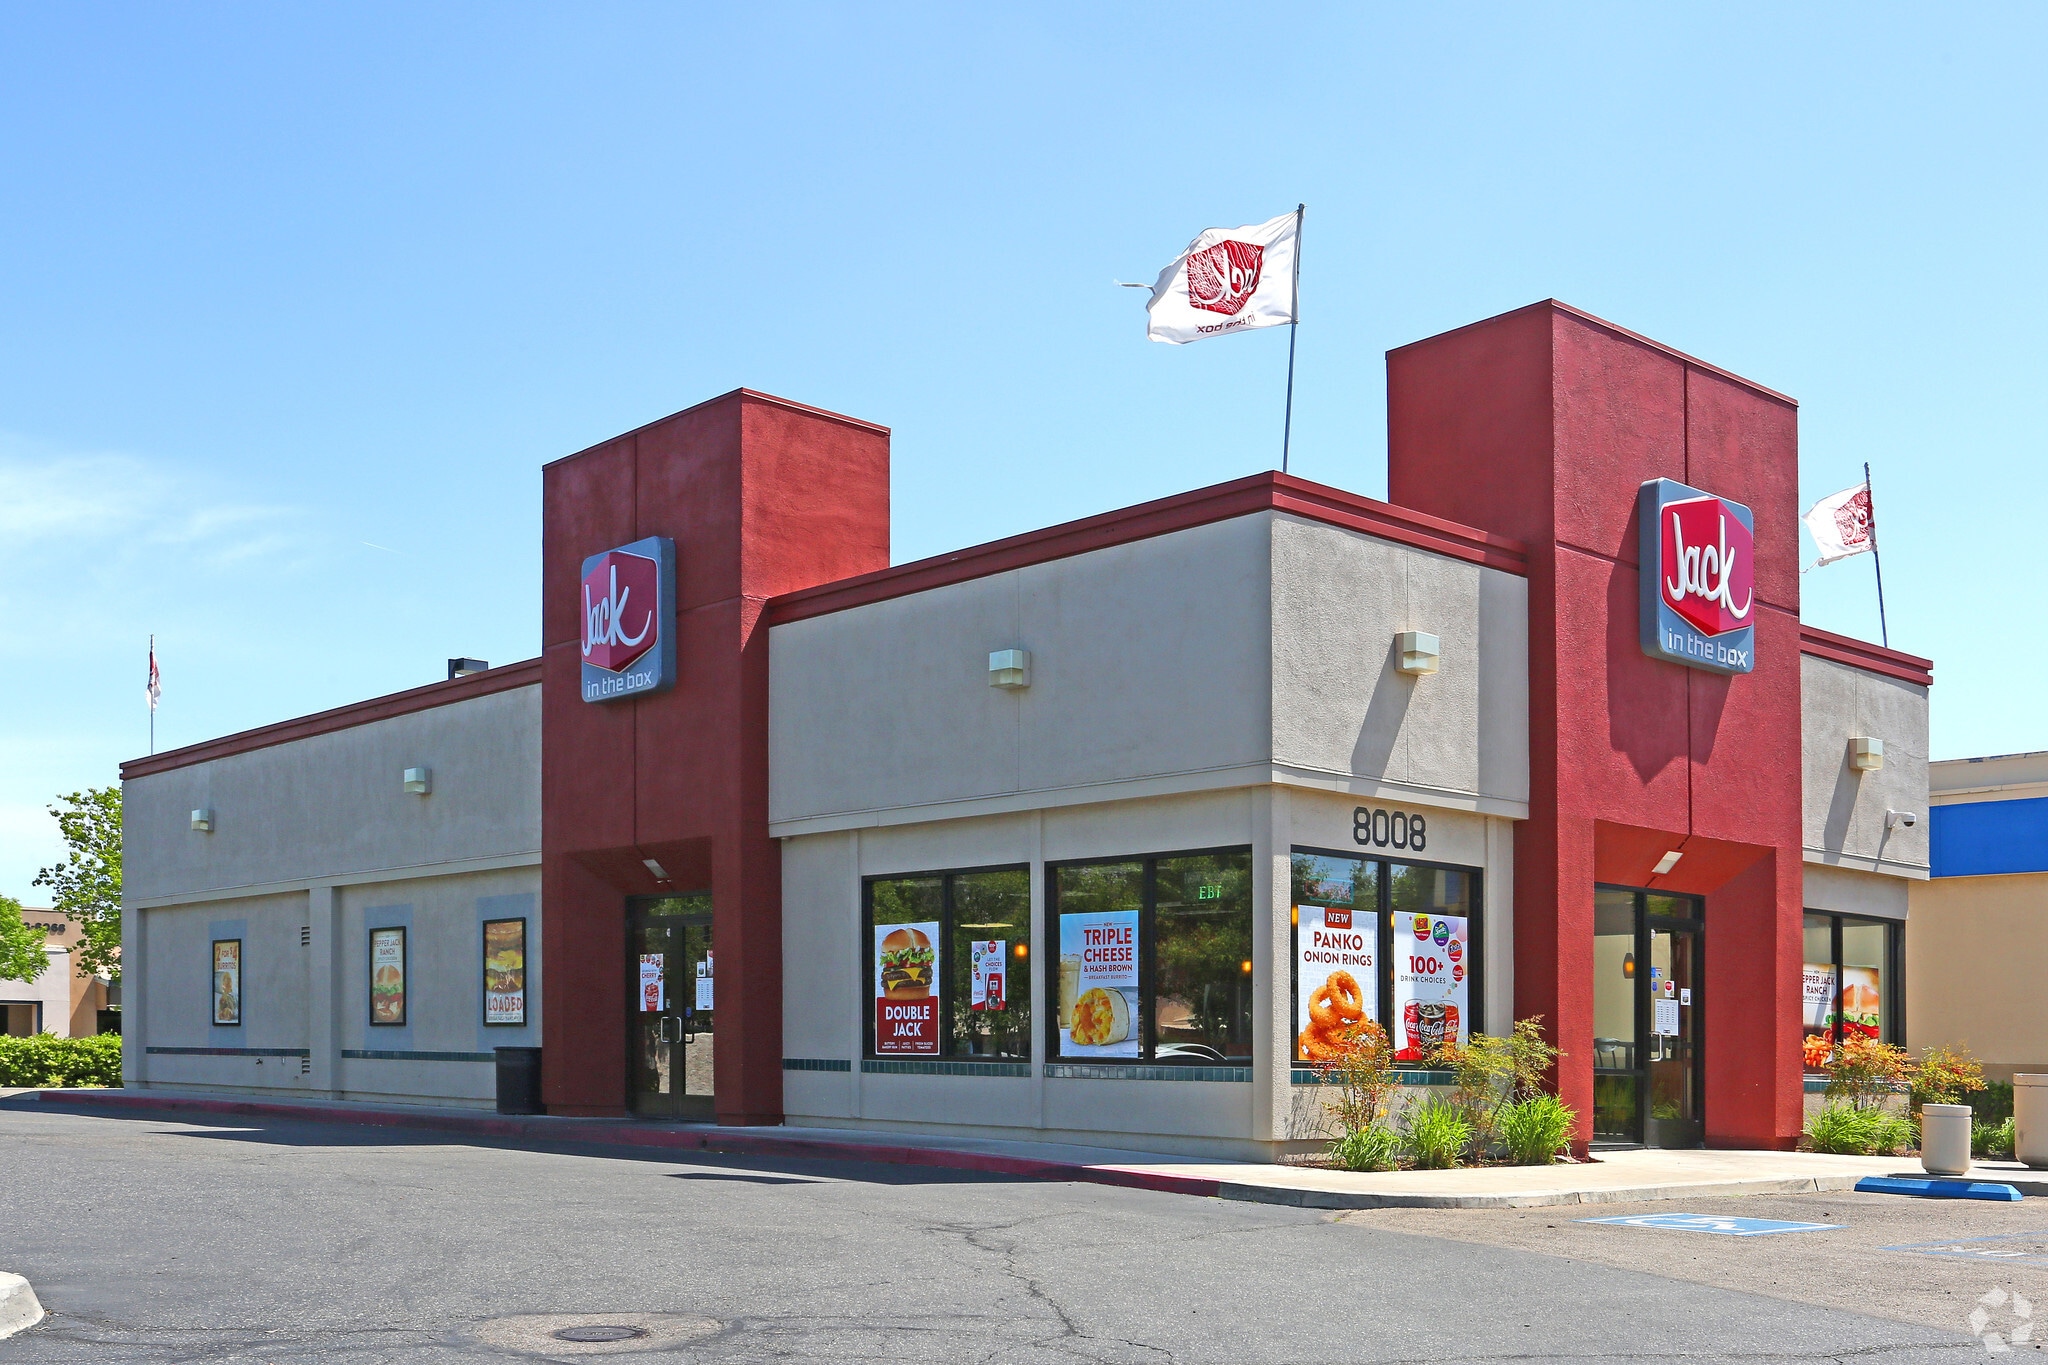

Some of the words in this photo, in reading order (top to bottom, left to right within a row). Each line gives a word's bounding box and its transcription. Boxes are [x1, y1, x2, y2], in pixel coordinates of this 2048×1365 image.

[1666, 511, 1752, 620] Jack
[582, 564, 652, 657] Jack
[1667, 627, 1684, 652] in
[1686, 633, 1714, 660] the
[1717, 641, 1748, 668] box
[587, 680, 600, 699] in
[602, 674, 624, 696] the
[626, 670, 652, 690] box
[1353, 806, 1426, 851] 8008
[1199, 885, 1222, 900] EBT
[1327, 912, 1350, 924] NEW
[1083, 927, 1133, 946] TRIPLE
[1313, 931, 1363, 951] PANKO
[1083, 947, 1133, 963] CHEESE
[1304, 951, 1340, 964] ONION
[1342, 953, 1373, 967] RINGS
[1108, 964, 1132, 972] BROWN
[1409, 955, 1444, 974] 100+
[1400, 975, 1420, 983] DRINK
[1420, 976, 1447, 984] CHOICES
[1802, 975, 1820, 985] EPPER
[1820, 976, 1835, 985] JACK
[1806, 985, 1828, 995] RANCH
[488, 995, 523, 1013] LOADED
[885, 1005, 930, 1020] DOUBLE
[893, 1022, 922, 1037] JACK
